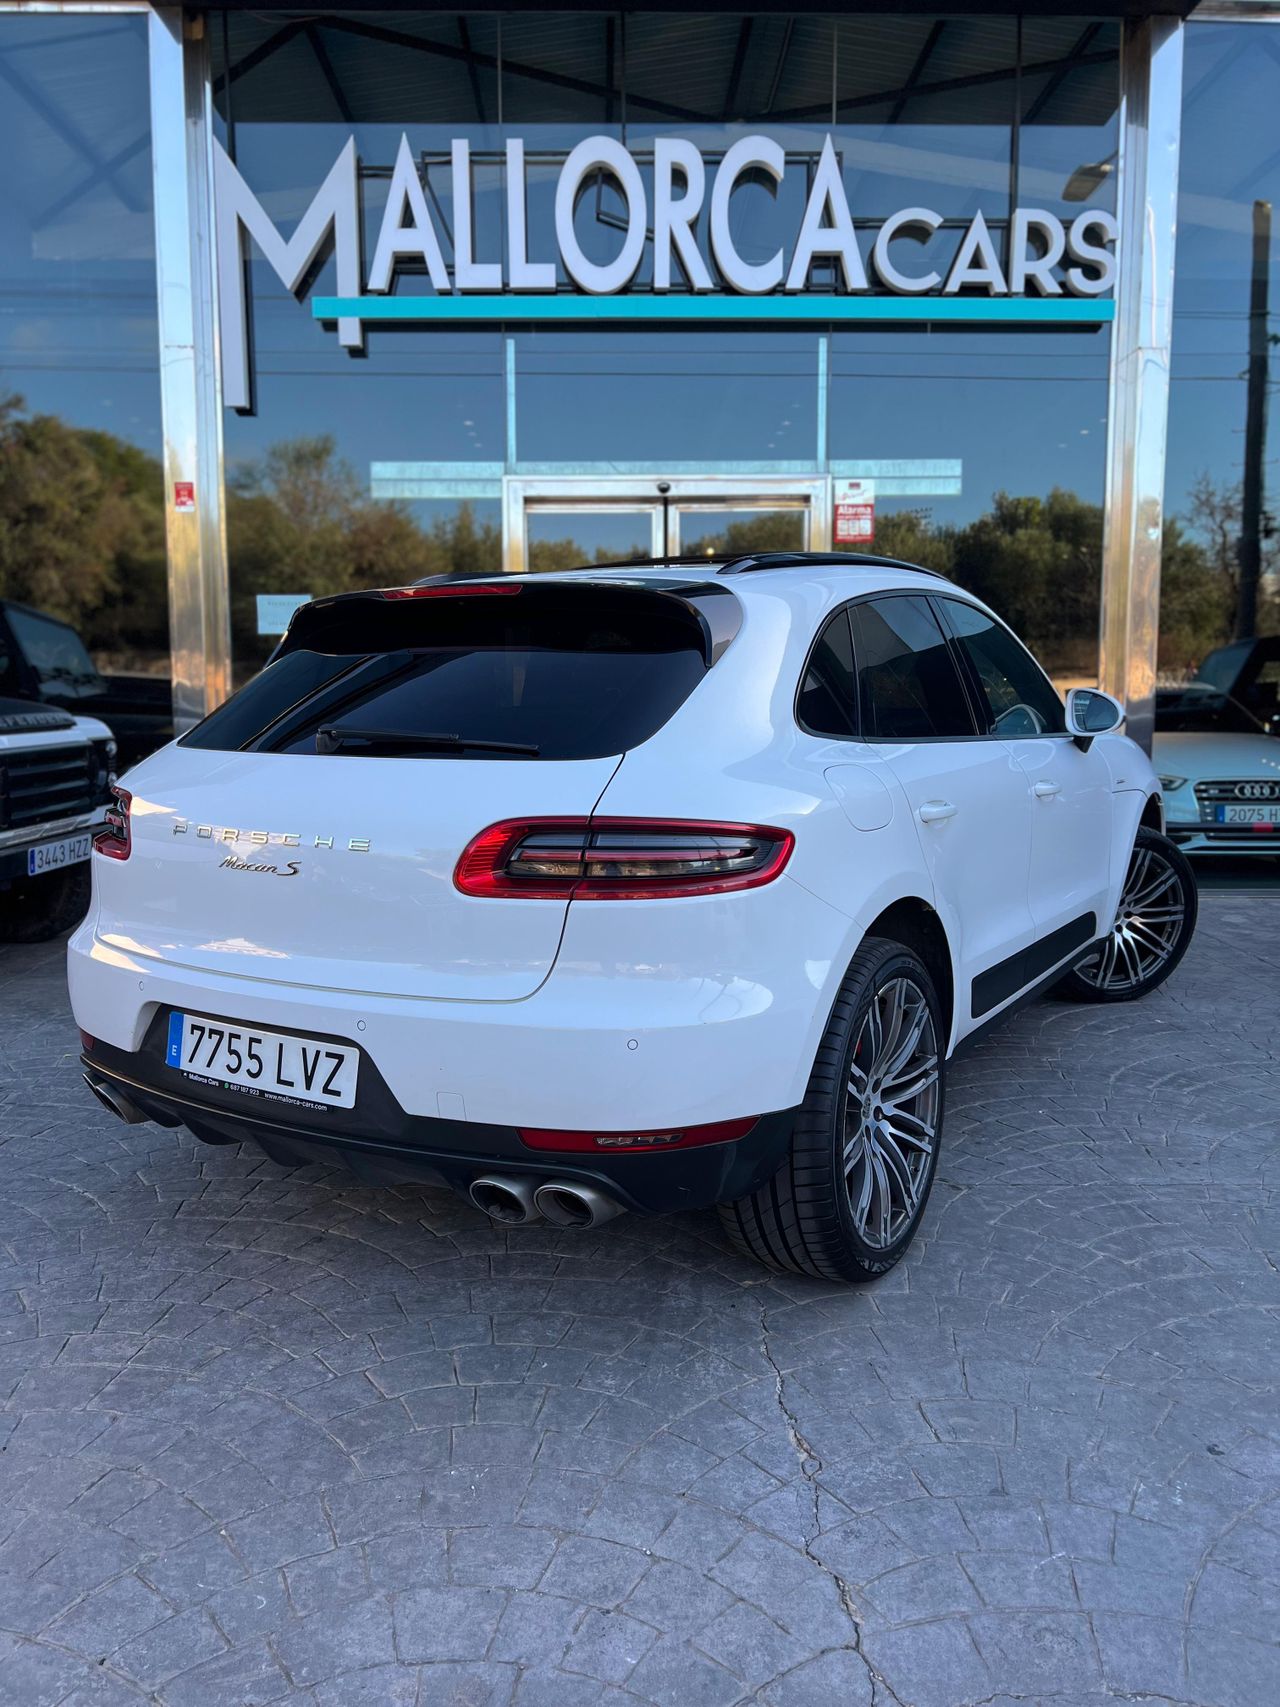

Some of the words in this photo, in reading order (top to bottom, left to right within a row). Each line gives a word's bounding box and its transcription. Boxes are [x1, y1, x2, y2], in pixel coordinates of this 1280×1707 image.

[212, 132, 869, 409] MALLORCA
[873, 207, 1119, 296] CARS
[837, 506, 872, 515] Alarma
[1229, 808, 1265, 822] 2075
[1269, 808, 1280, 822] H
[173, 824, 372, 853] PORSCHE
[37, 845, 66, 869] 3443
[69, 838, 89, 861] HZZ
[218, 855, 278, 874] Macan
[276, 860, 302, 877] S
[188, 1024, 263, 1079] 7755
[276, 1043, 345, 1097] LVZ
[188, 1073, 208, 1085] Mallorca
[207, 1078, 220, 1088] Cars
